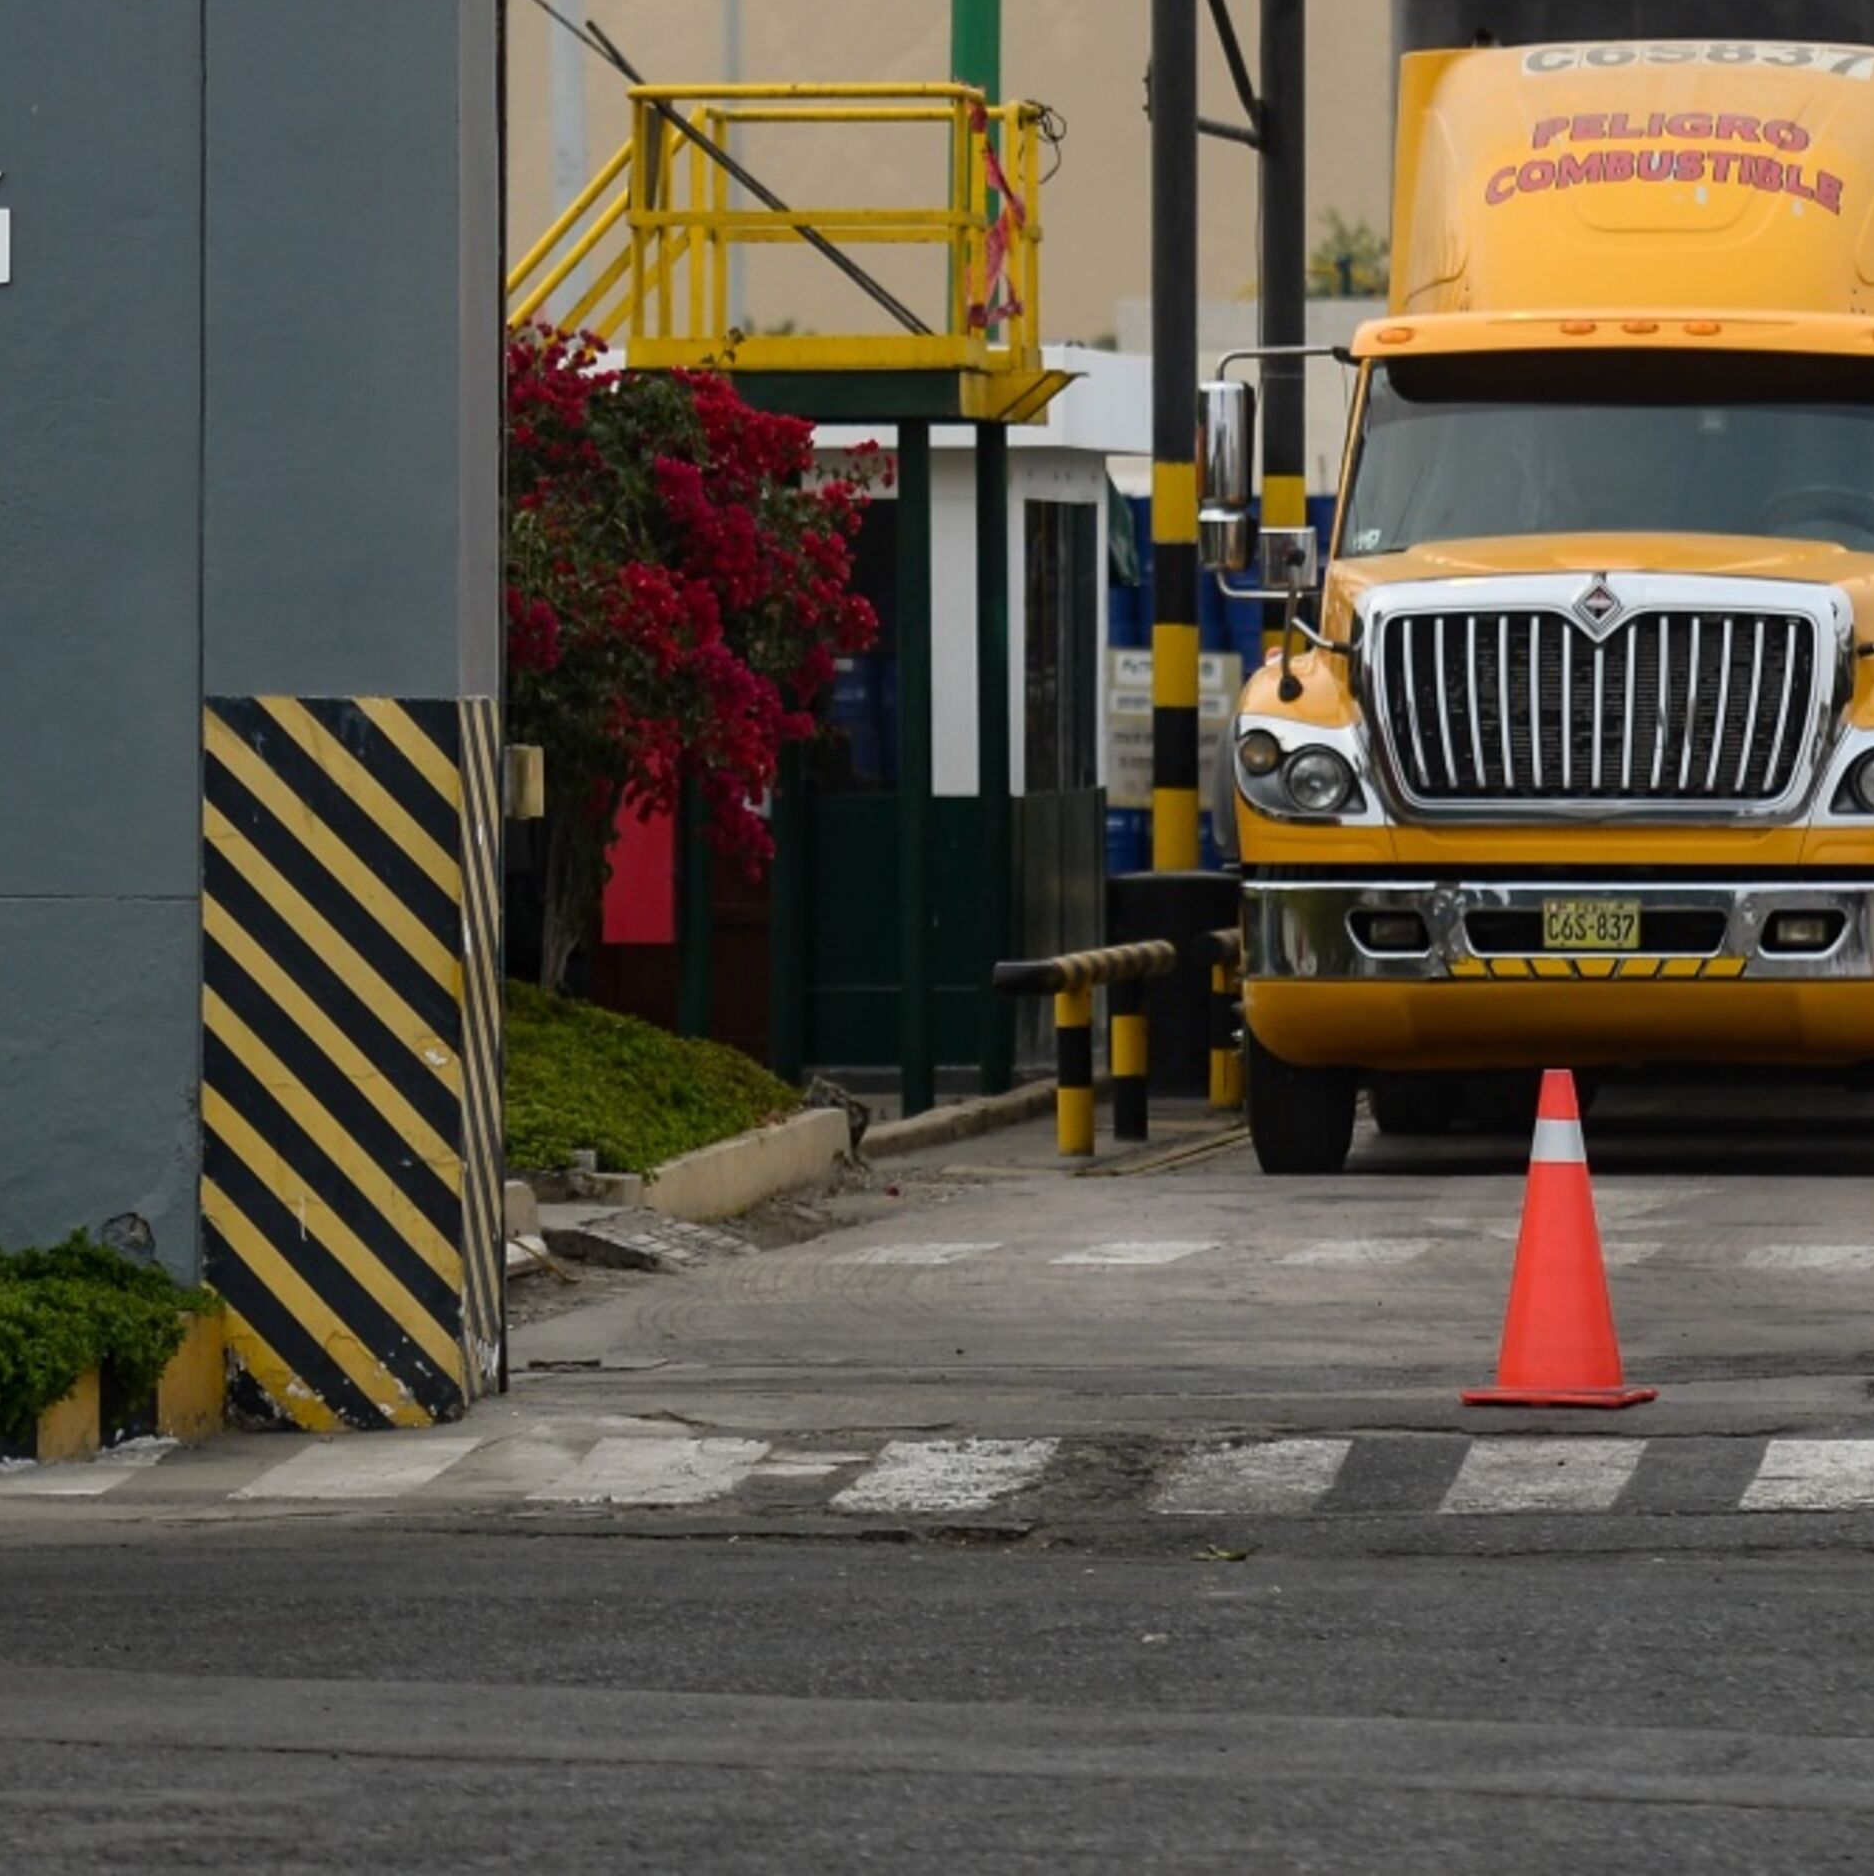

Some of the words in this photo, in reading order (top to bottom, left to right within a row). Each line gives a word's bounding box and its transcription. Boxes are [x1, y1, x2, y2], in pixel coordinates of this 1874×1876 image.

[1532, 112, 1811, 153] PELIGRO
[1484, 149, 1845, 216] COMBUSTIBLE
[1547, 913, 1635, 941] C6S-837
